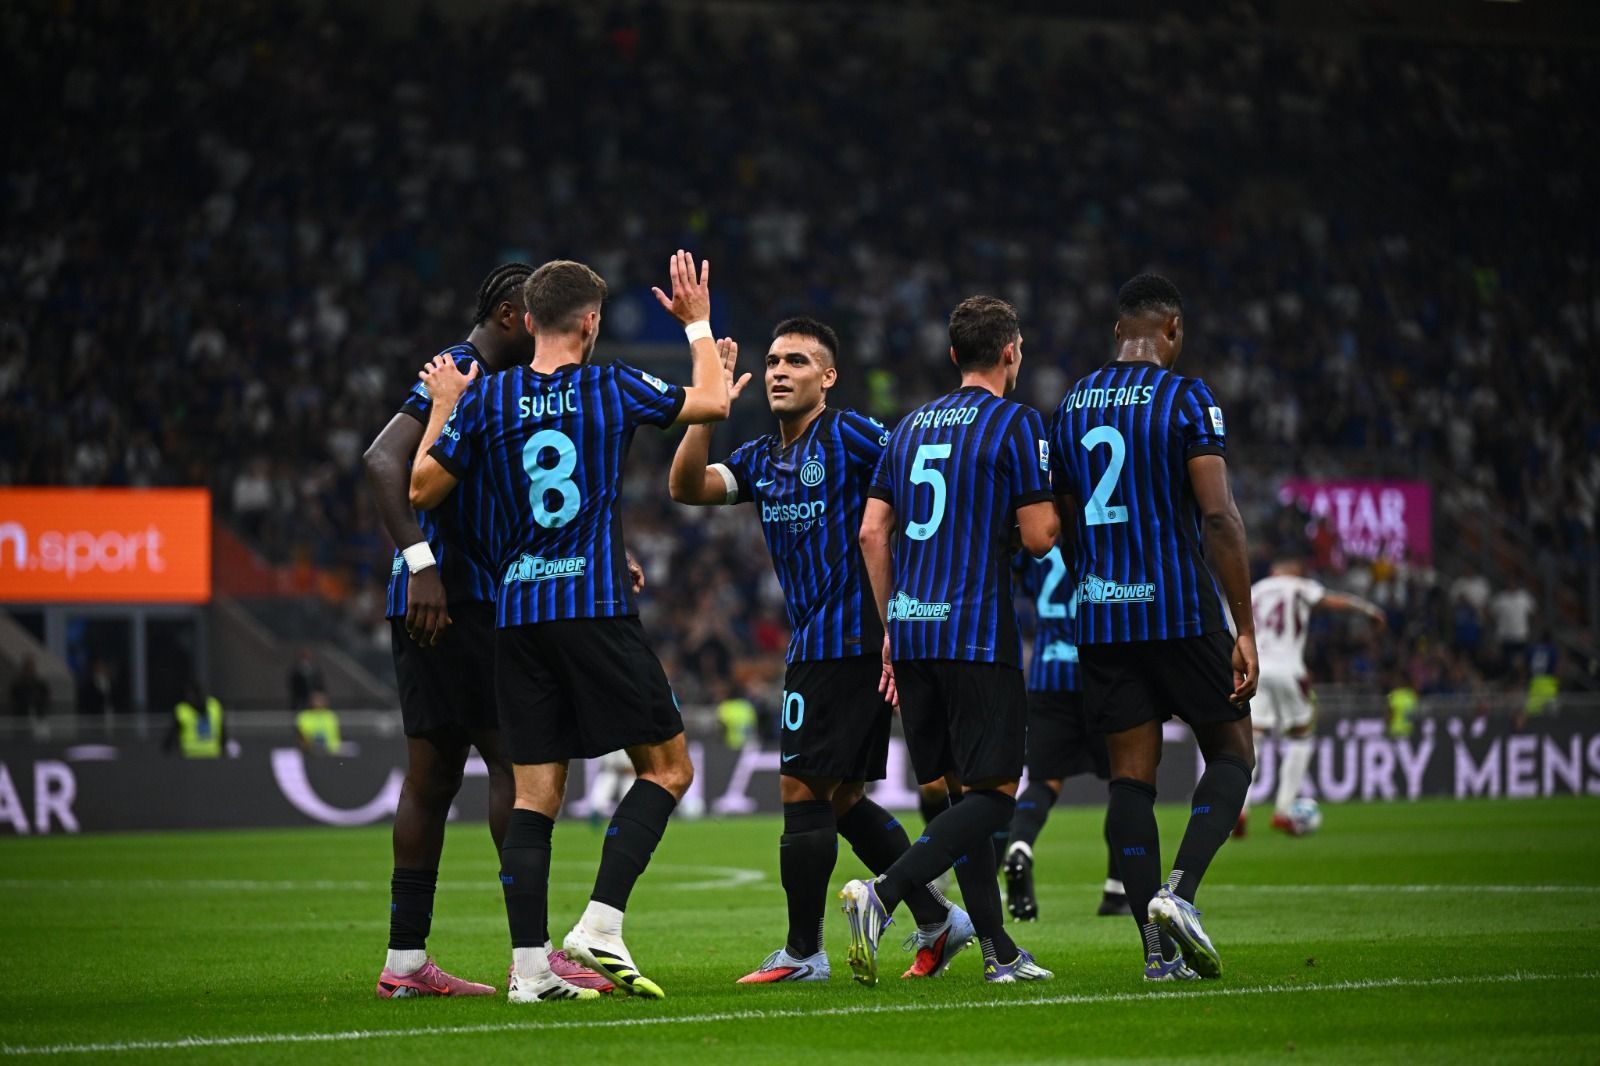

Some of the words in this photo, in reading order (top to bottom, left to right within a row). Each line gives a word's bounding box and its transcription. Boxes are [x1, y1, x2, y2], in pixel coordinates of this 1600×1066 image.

[518, 382, 577, 418] SUČIĆ
[910, 406, 979, 431] PAVARD
[1066, 385, 1154, 413] DUMFRIES
[522, 429, 581, 528] 8
[905, 443, 952, 541] 5
[1081, 425, 1129, 526] 2
[761, 500, 826, 523] betsson
[781, 690, 805, 731] 10
[1197, 735, 1436, 802] UURY
